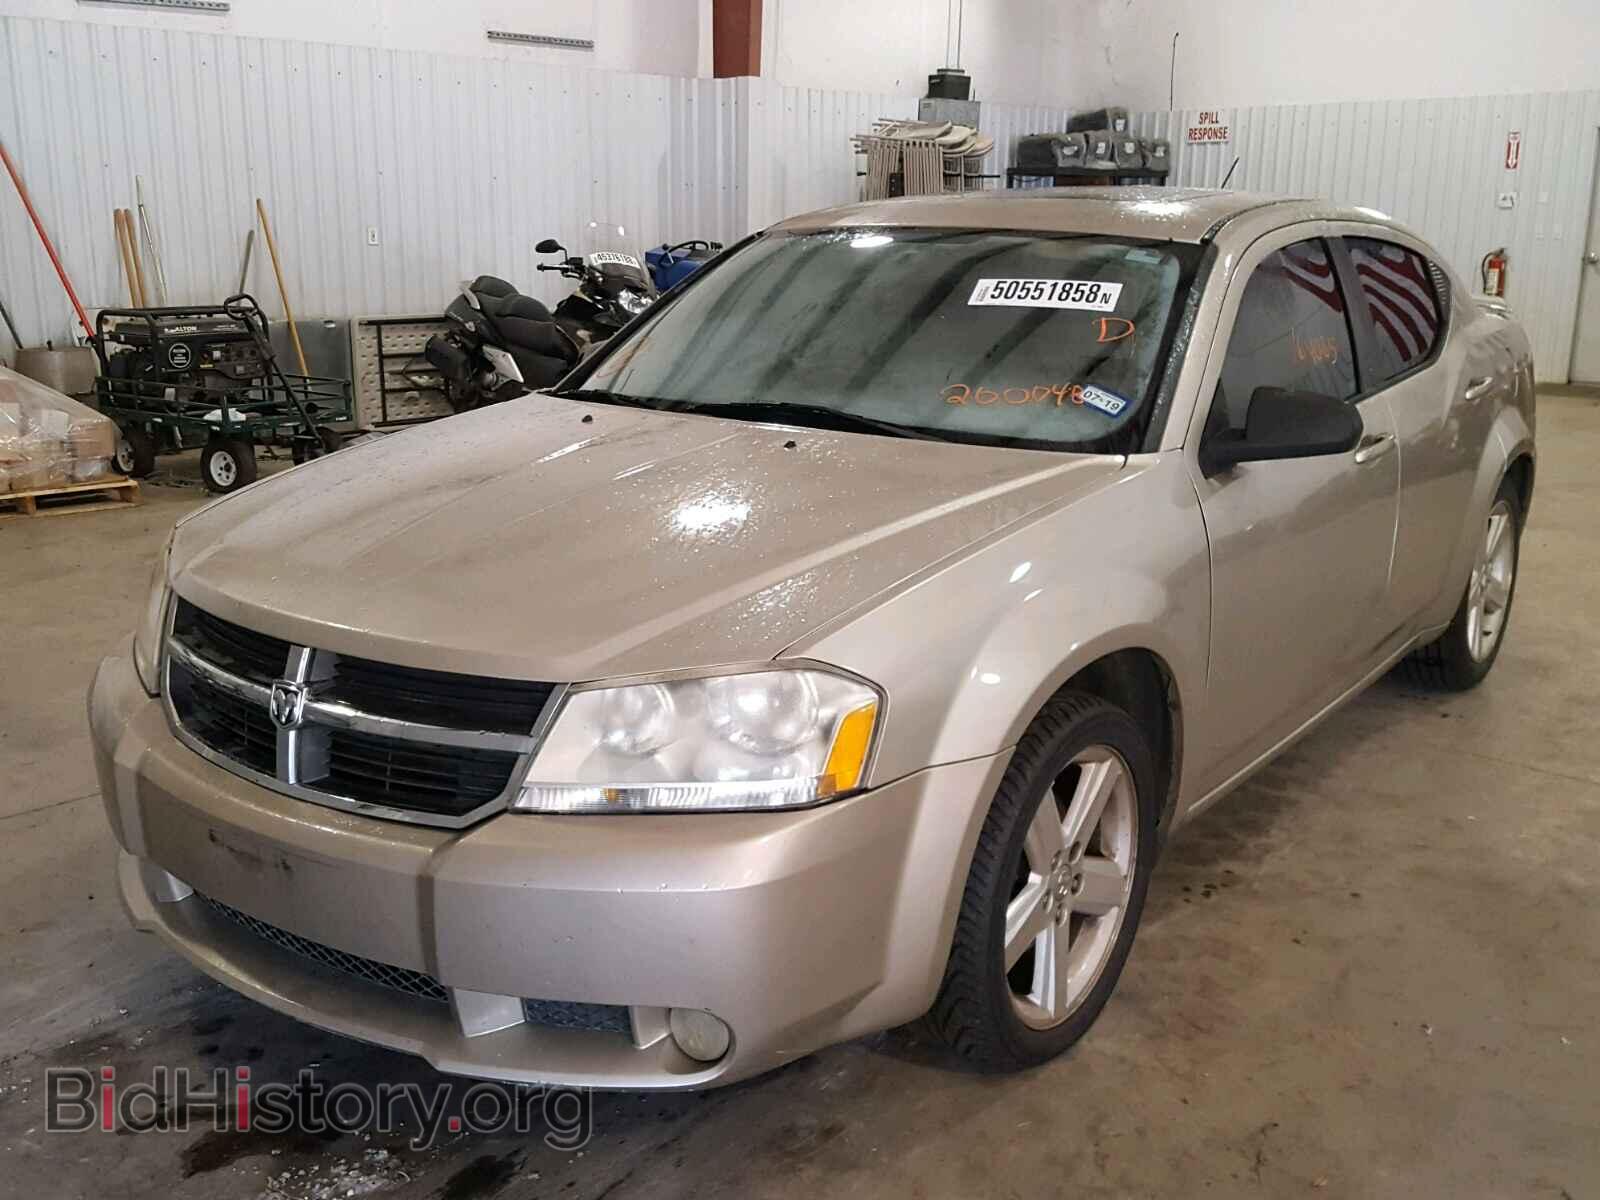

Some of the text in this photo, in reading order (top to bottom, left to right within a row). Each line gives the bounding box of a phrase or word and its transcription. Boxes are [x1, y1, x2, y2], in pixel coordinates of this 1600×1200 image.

[1198, 111, 1219, 124] SPILL
[1188, 126, 1229, 141] RESPONSE
[990, 280, 1101, 304] 50551858
[1100, 292, 1112, 305] N
[1091, 316, 1135, 342] D
[1083, 390, 1121, 411] 07-19
